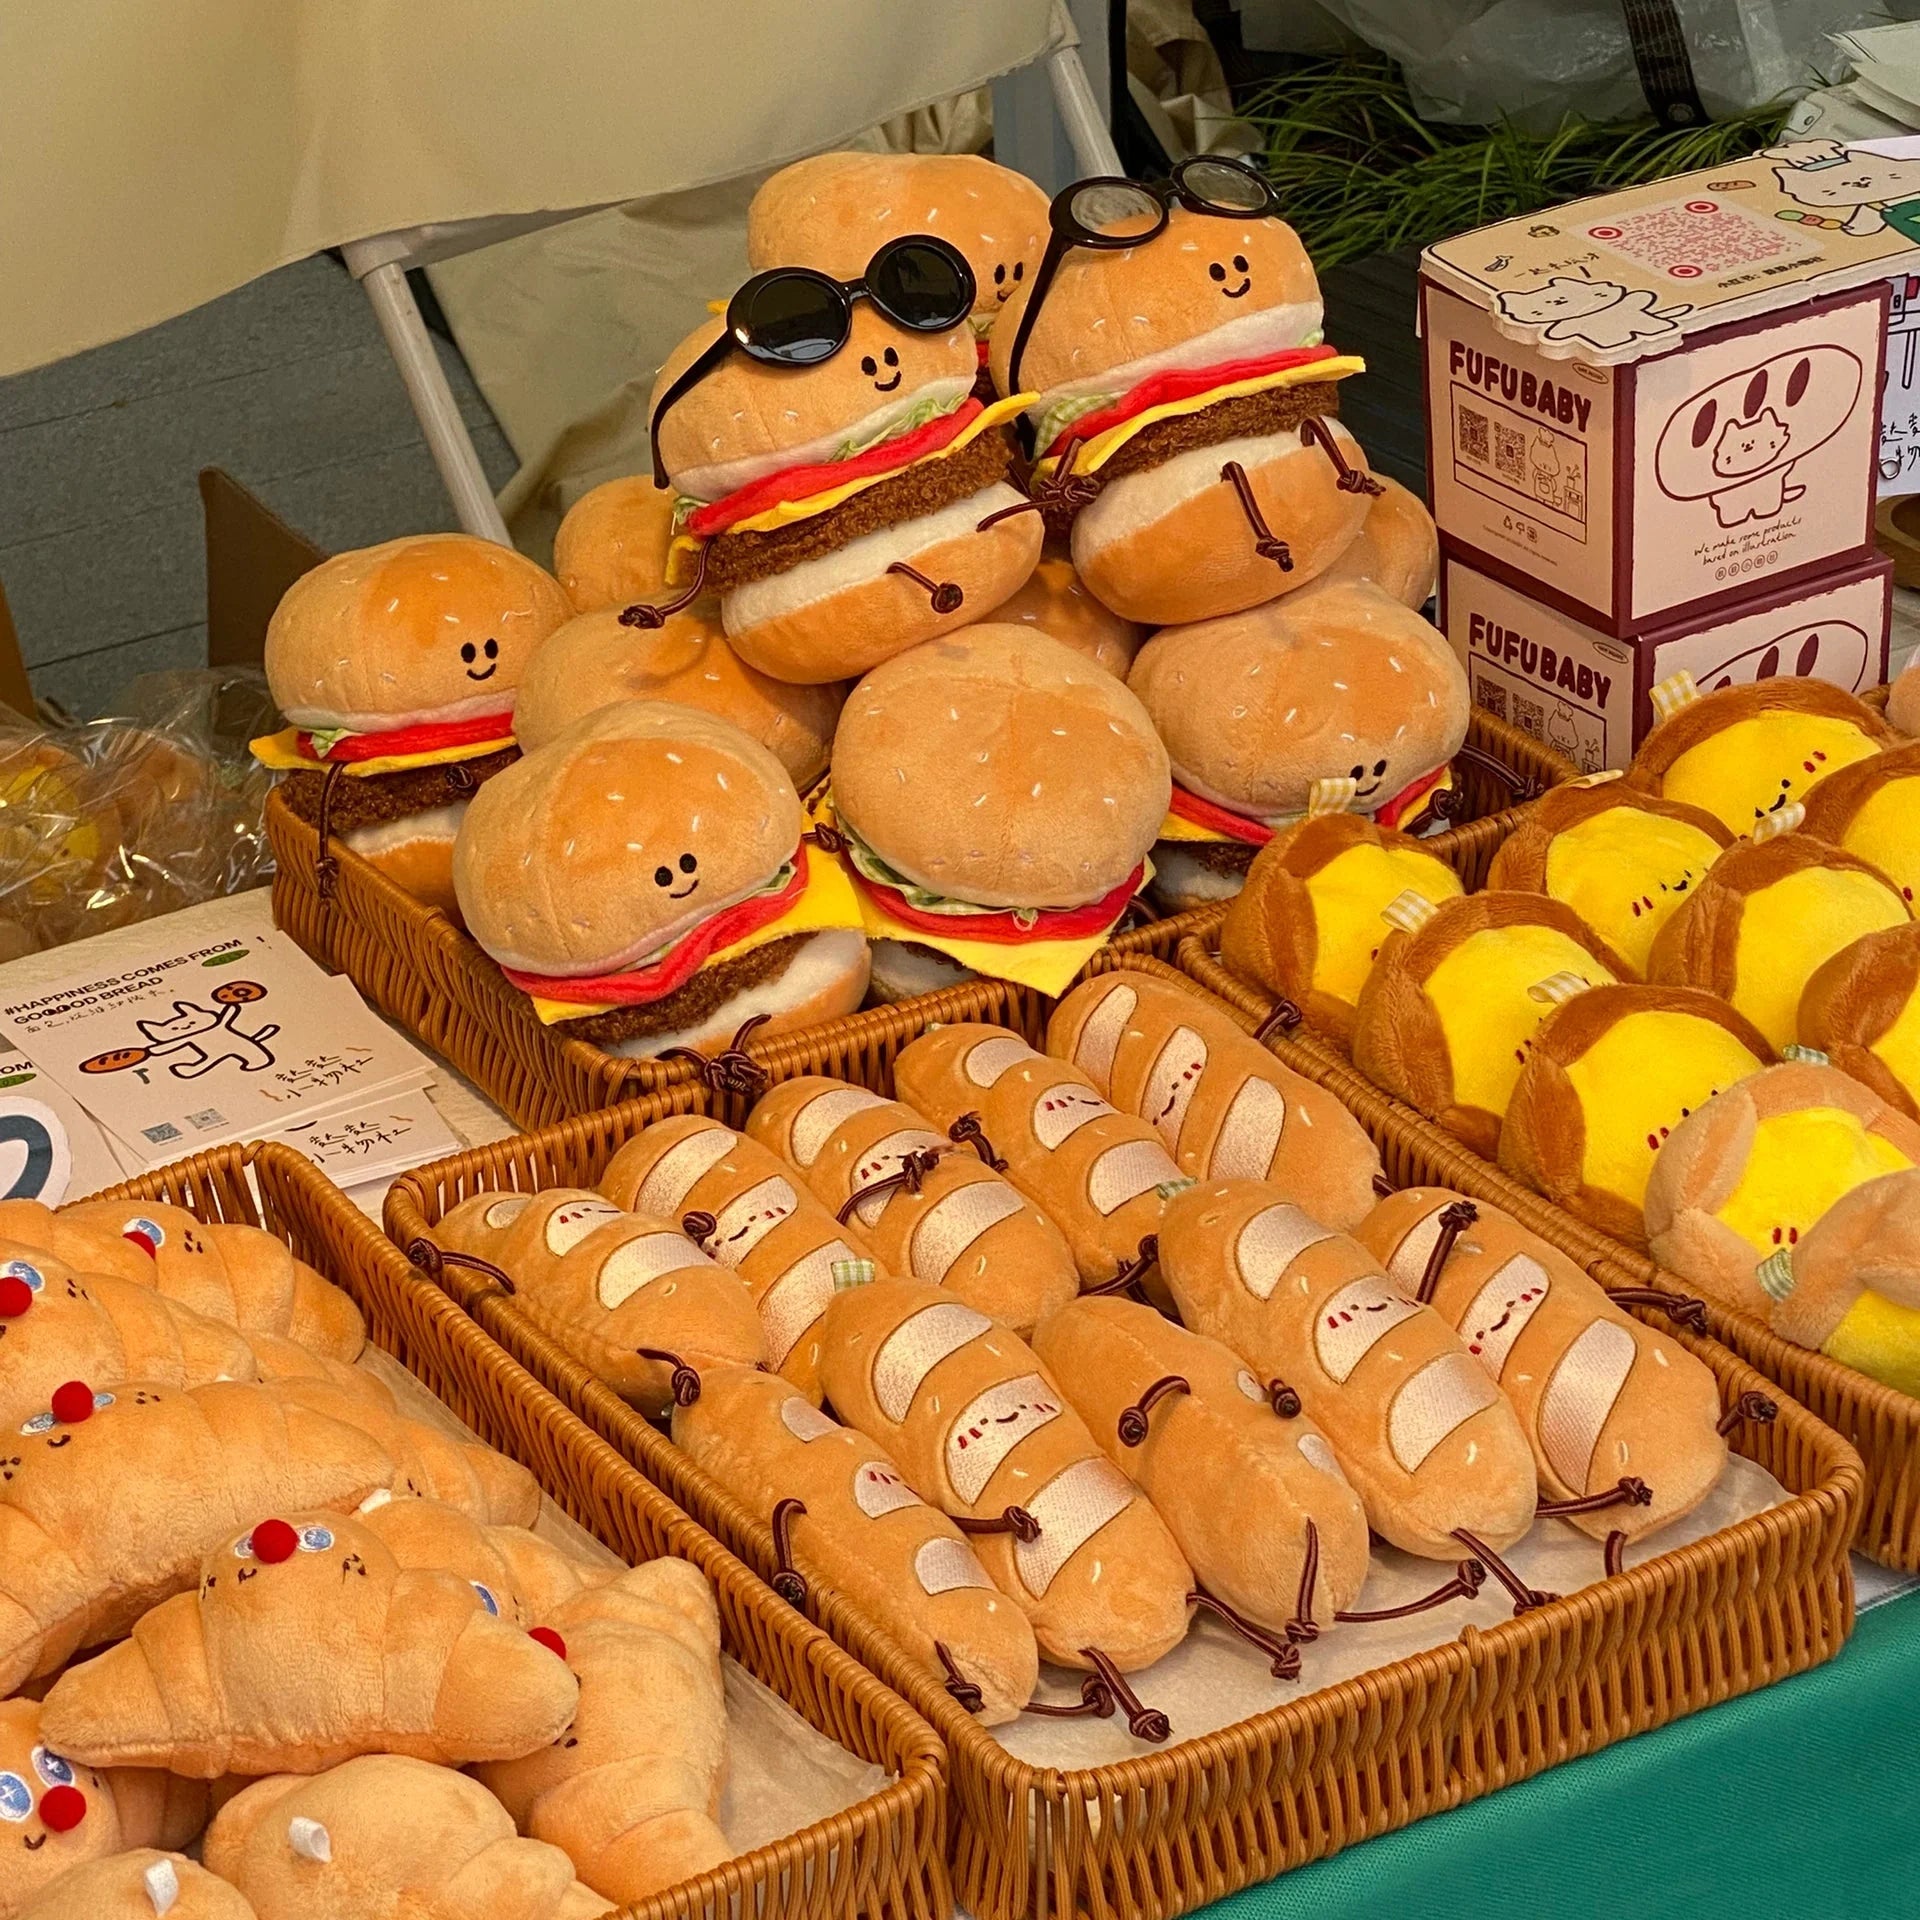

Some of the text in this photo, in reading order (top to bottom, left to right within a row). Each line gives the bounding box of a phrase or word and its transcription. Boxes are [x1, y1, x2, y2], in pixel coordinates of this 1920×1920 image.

[1449, 339, 1592, 433] FUFUBABY
[1694, 516, 1802, 556] We make some products
[1703, 531, 1797, 565] based on illustration
[1469, 612, 1612, 709] FUFUBABY
[4, 938, 243, 1017] #HAPPINESS COMES FROM
[99, 976, 163, 1000] BREAD
[0, 1060, 34, 1075] OM
